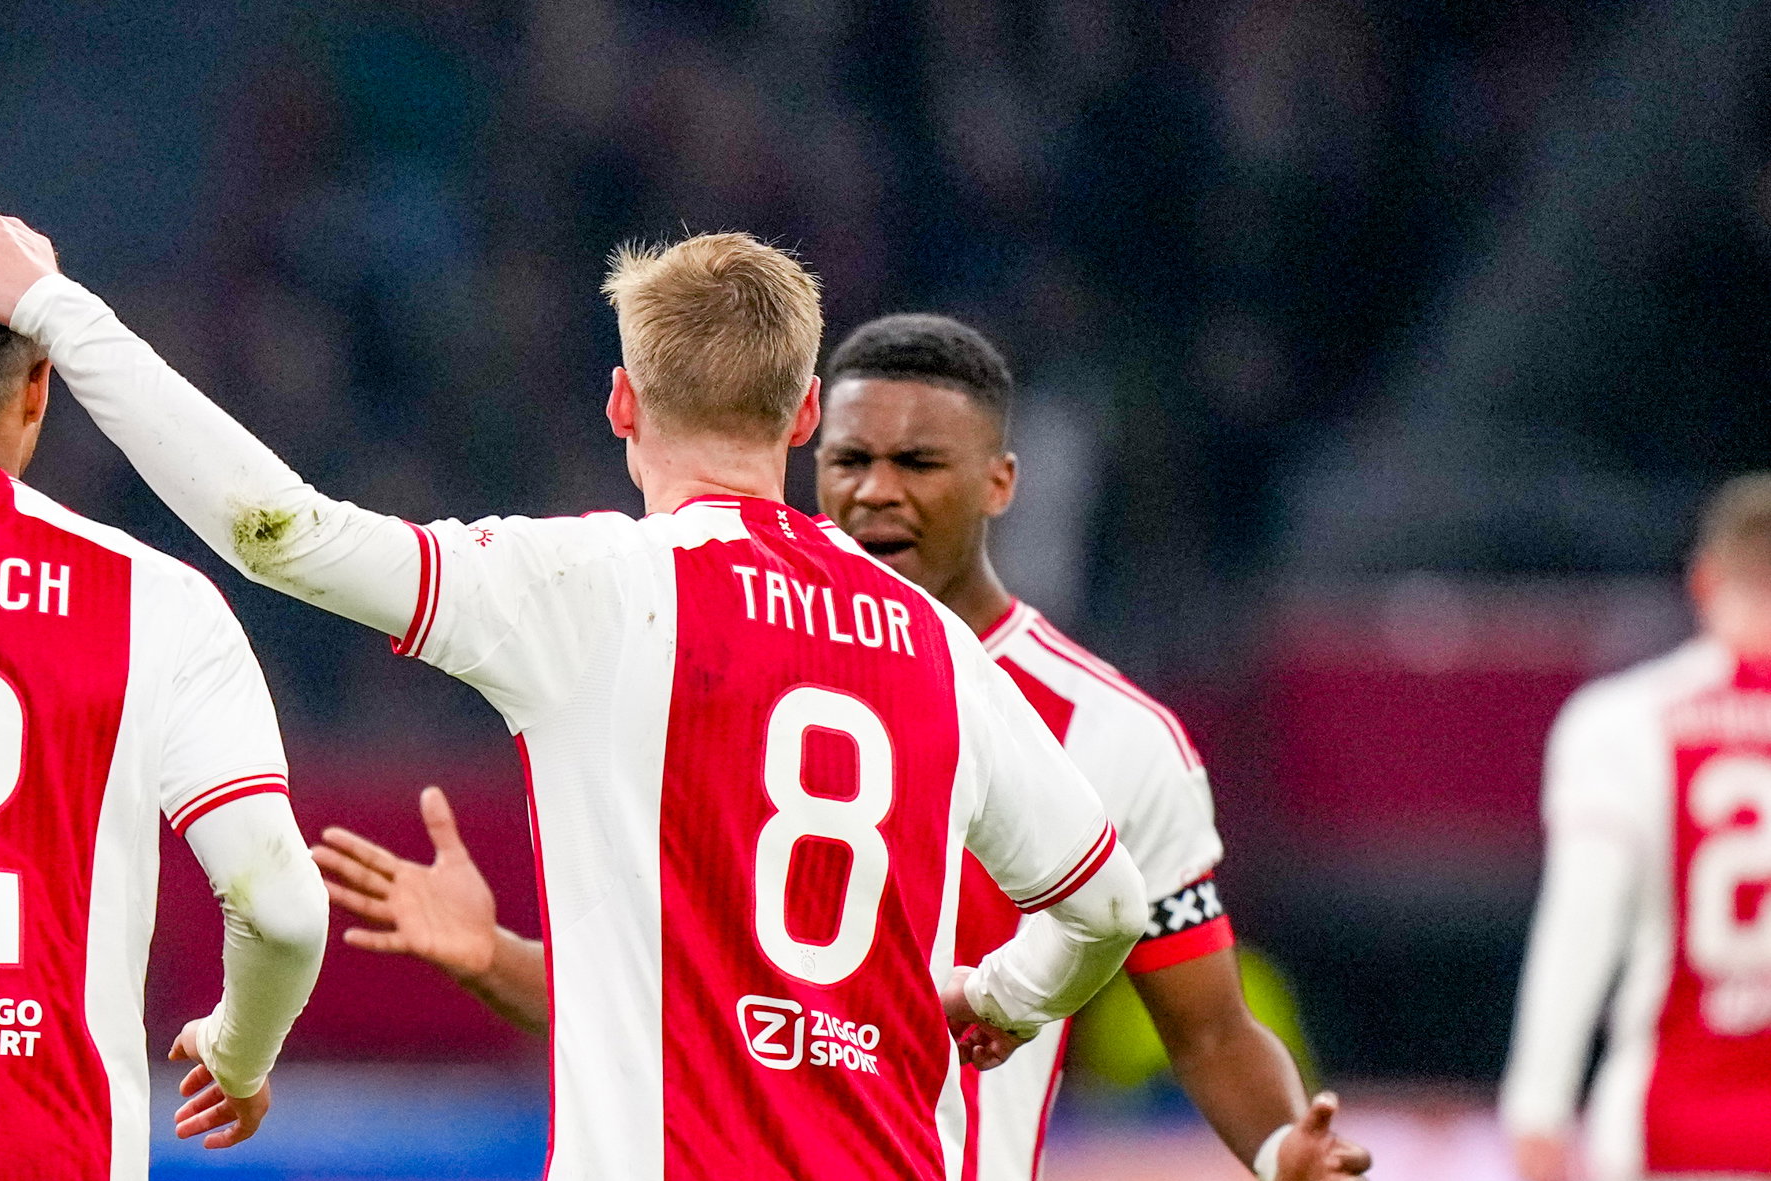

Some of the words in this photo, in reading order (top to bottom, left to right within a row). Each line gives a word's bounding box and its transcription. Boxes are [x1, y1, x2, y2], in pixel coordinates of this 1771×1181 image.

[731, 563, 916, 657] TAYLOR
[753, 685, 894, 986] 8
[808, 1040, 881, 1077] SPORT
[810, 1009, 881, 1051] ZIGGO
